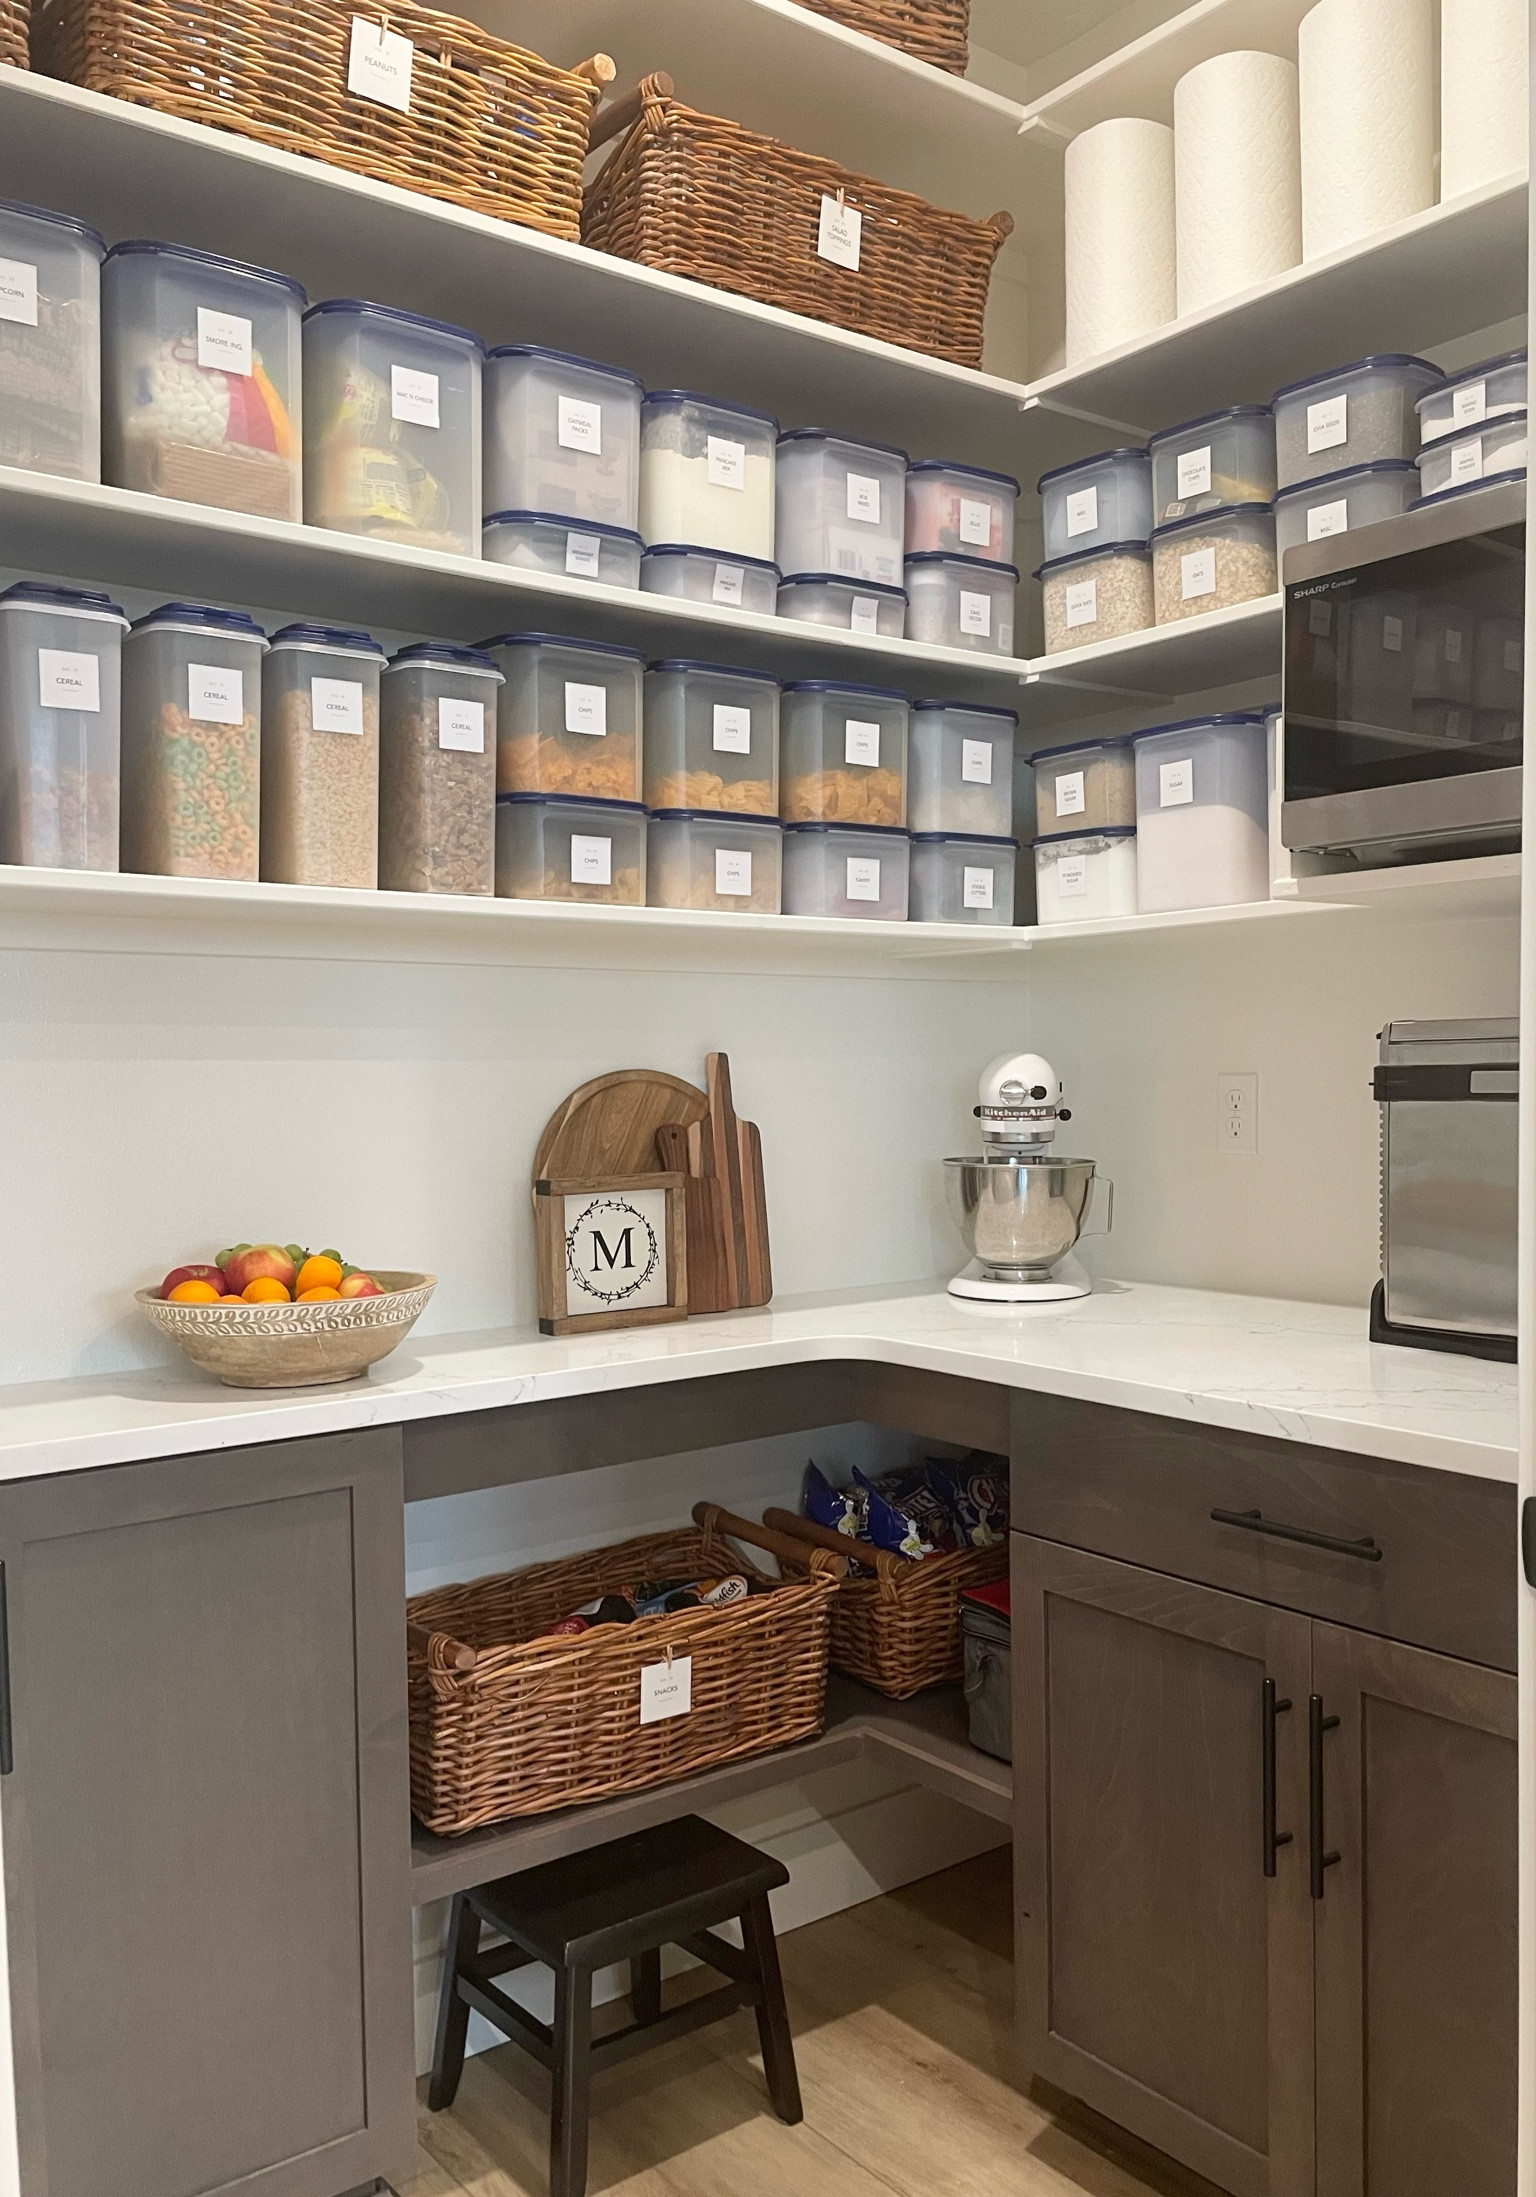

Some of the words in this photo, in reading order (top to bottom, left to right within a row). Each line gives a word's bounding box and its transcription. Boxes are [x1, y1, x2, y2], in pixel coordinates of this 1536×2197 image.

[364, 56, 397, 76] PEANUTS
[831, 224, 848, 237] SALAD
[826, 231, 852, 248] TOPPINGS
[0, 286, 25, 299] PCORN
[205, 335, 229, 348] SMORE
[567, 417, 593, 429] OATMEAL
[1312, 423, 1326, 433] CHIA
[1325, 419, 1341, 430] SEEDS
[571, 425, 589, 435] PACKS
[1181, 465, 1207, 478] CHOCOLATE
[1293, 583, 1329, 600] SHARP
[56, 676, 84, 687] CEREAL
[203, 690, 229, 701] CEREAL
[326, 702, 350, 712] CEREAL
[578, 706, 593, 714] CHIPS
[451, 721, 473, 731] CEREAL
[724, 726, 738, 734] CHIPS
[855, 741, 869, 749] CHIPS
[1169, 780, 1183, 788] SUGAR
[584, 857, 598, 865] CHIPS
[984, 1107, 1048, 1117] KitchenAid
[589, 1227, 636, 1272] M
[714, 1580, 741, 1604] dfish
[653, 1684, 679, 1697] SNACKS
